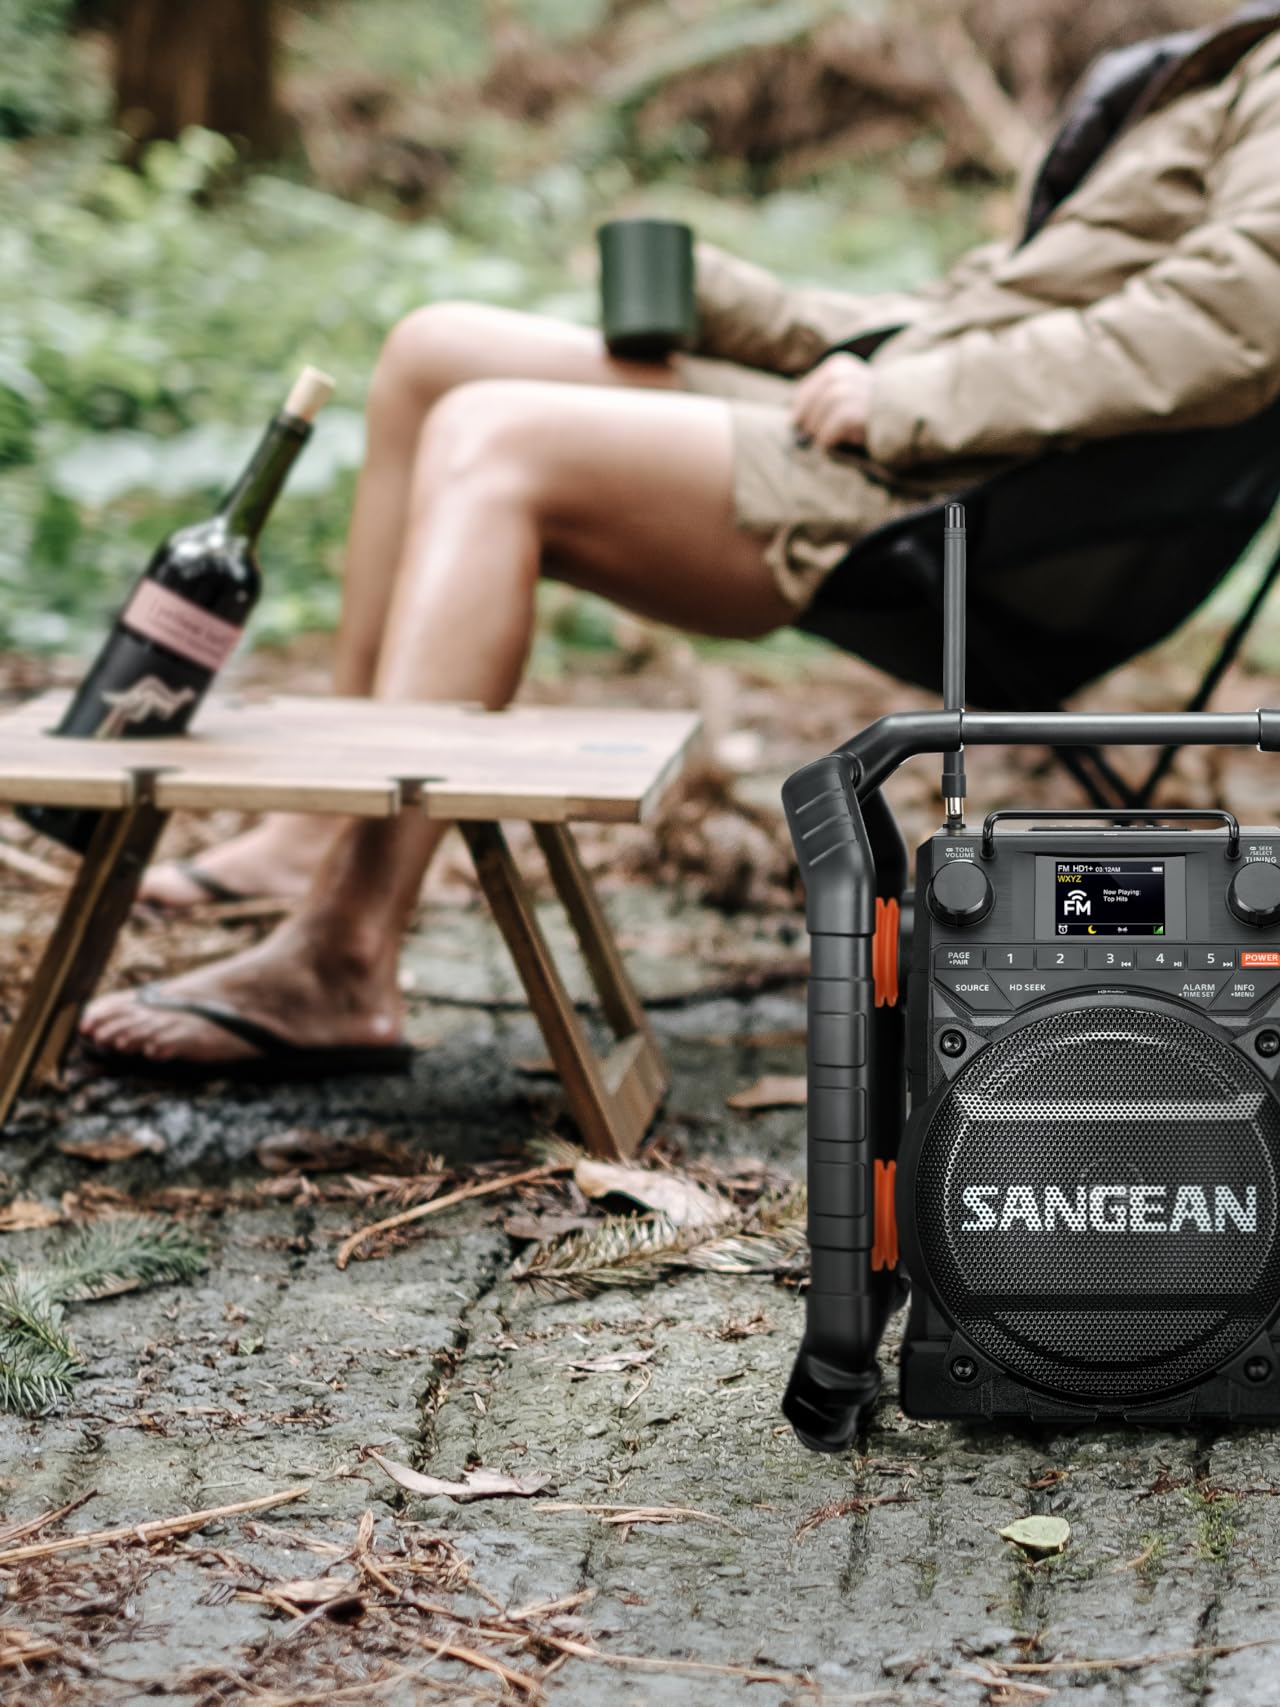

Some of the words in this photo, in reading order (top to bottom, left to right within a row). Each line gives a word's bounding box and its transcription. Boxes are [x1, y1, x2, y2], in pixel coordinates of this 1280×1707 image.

[1057, 875, 1082, 883] WXYZ
[1064, 900, 1091, 915] FM
[1006, 953, 1013, 964] 1
[1056, 953, 1065, 964] 2
[1106, 953, 1115, 964] 3
[1155, 953, 1165, 964] 4
[1207, 953, 1215, 964] 5
[955, 984, 990, 992] SOURCE
[1009, 983, 1023, 991] HD
[1024, 983, 1046, 991] SEEK
[1182, 983, 1216, 991] ALARM
[1234, 983, 1255, 992] INFO
[961, 1185, 1257, 1232] SANGEAN
